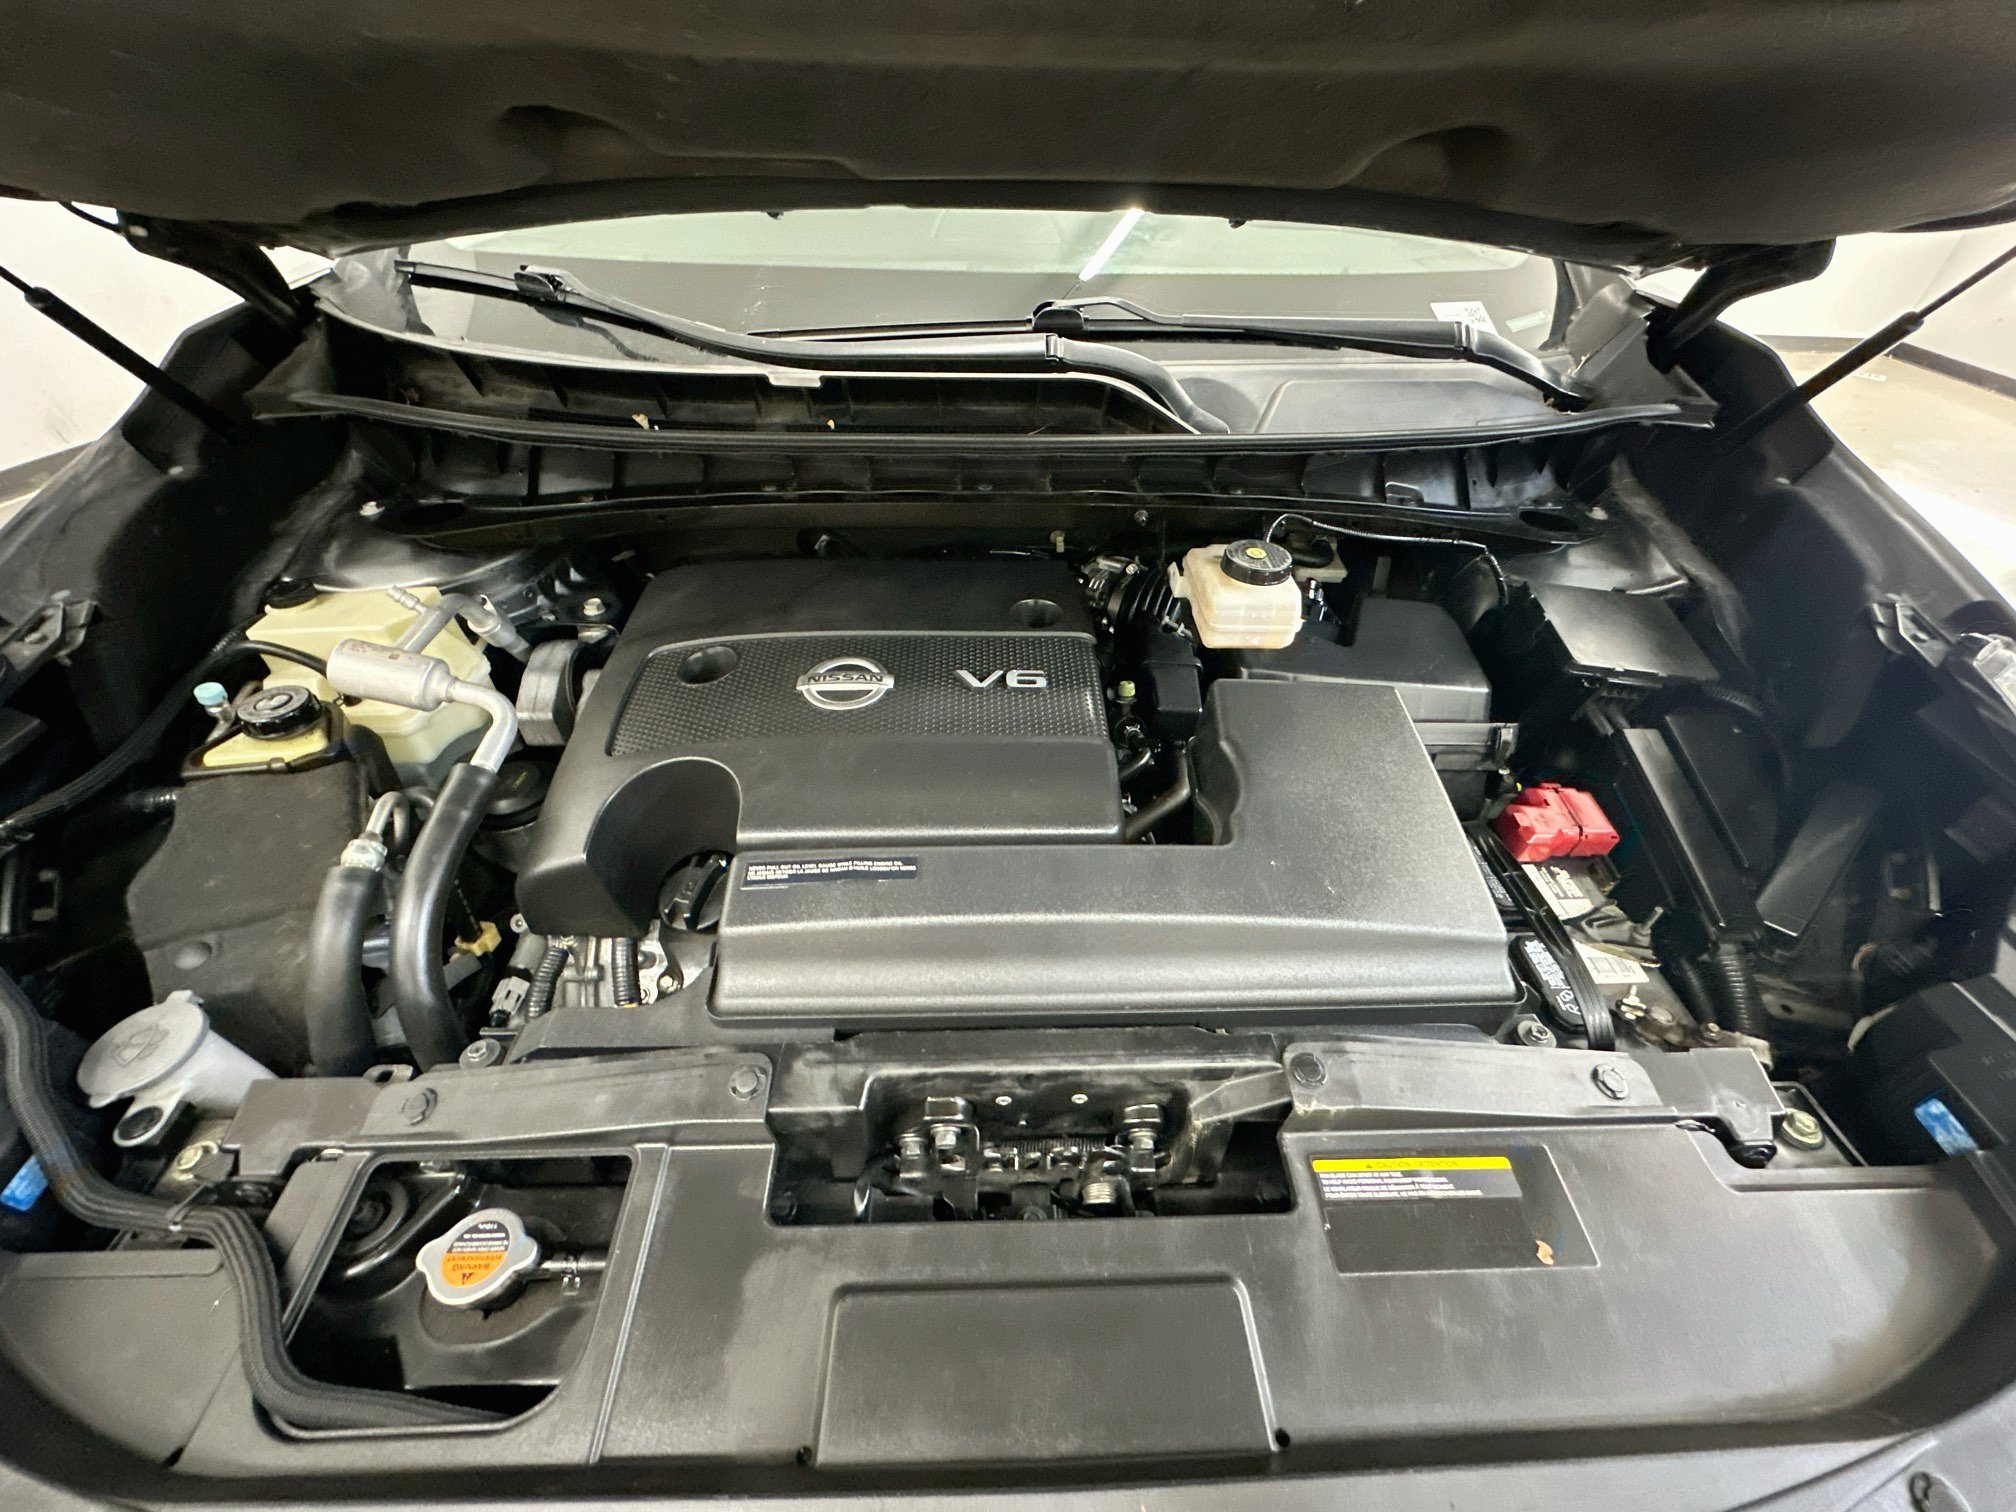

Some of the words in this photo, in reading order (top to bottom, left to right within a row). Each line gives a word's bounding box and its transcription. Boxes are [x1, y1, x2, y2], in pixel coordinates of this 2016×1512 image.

[807, 673, 884, 684] NISSAN
[953, 669, 1048, 691] V6
[1376, 1160, 1411, 1169] CAUTION
[1418, 1160, 1459, 1168] ATTENTION
[451, 1263, 490, 1271] WARNING
